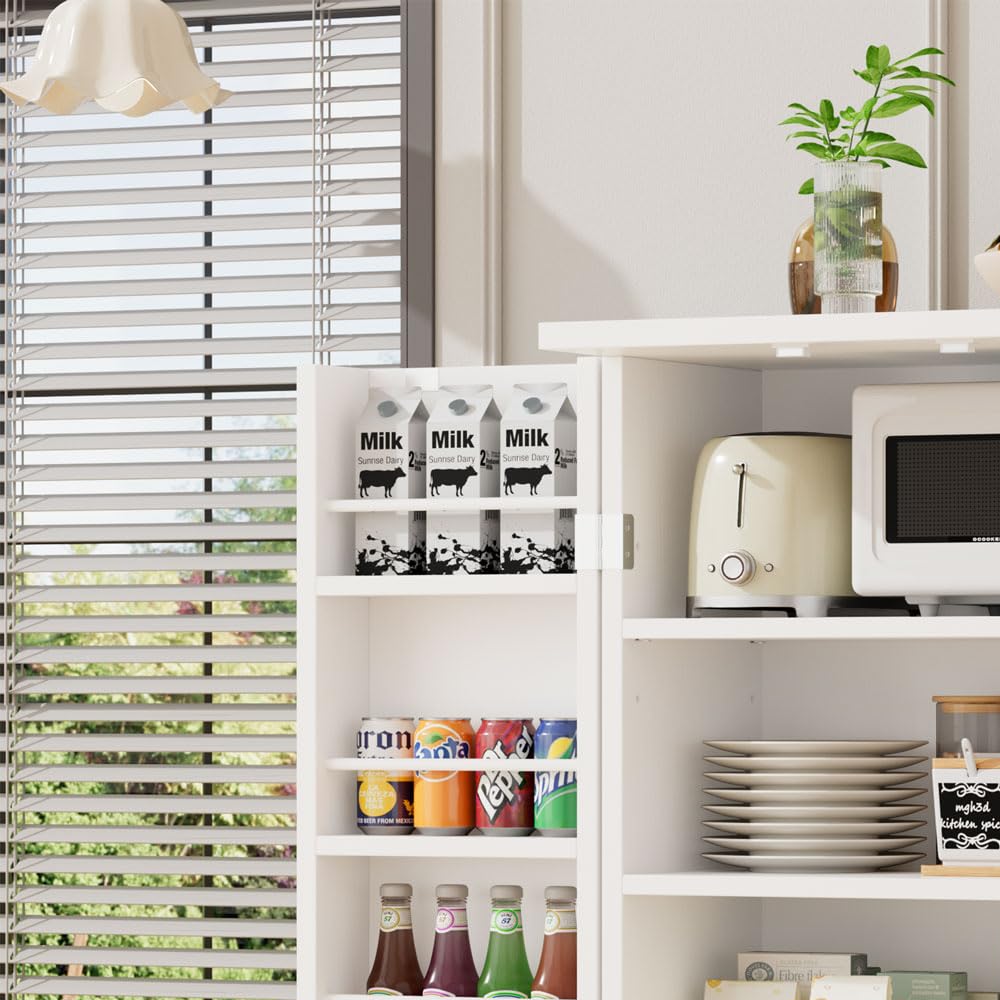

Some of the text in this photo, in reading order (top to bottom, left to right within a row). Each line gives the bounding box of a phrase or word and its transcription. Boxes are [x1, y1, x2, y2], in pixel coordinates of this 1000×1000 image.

[361, 432, 403, 450] Milk
[432, 430, 474, 448] Milk
[505, 428, 549, 447] Milk
[358, 456, 384, 465] Sunrise
[386, 456, 404, 466] Dairy
[429, 455, 455, 464] Sunrise
[457, 455, 476, 464] Dairy
[503, 454, 529, 463] Sunrise
[531, 453, 550, 463] Dairy
[955, 800, 991, 815] mgh3d
[940, 817, 977, 830] kitchen
